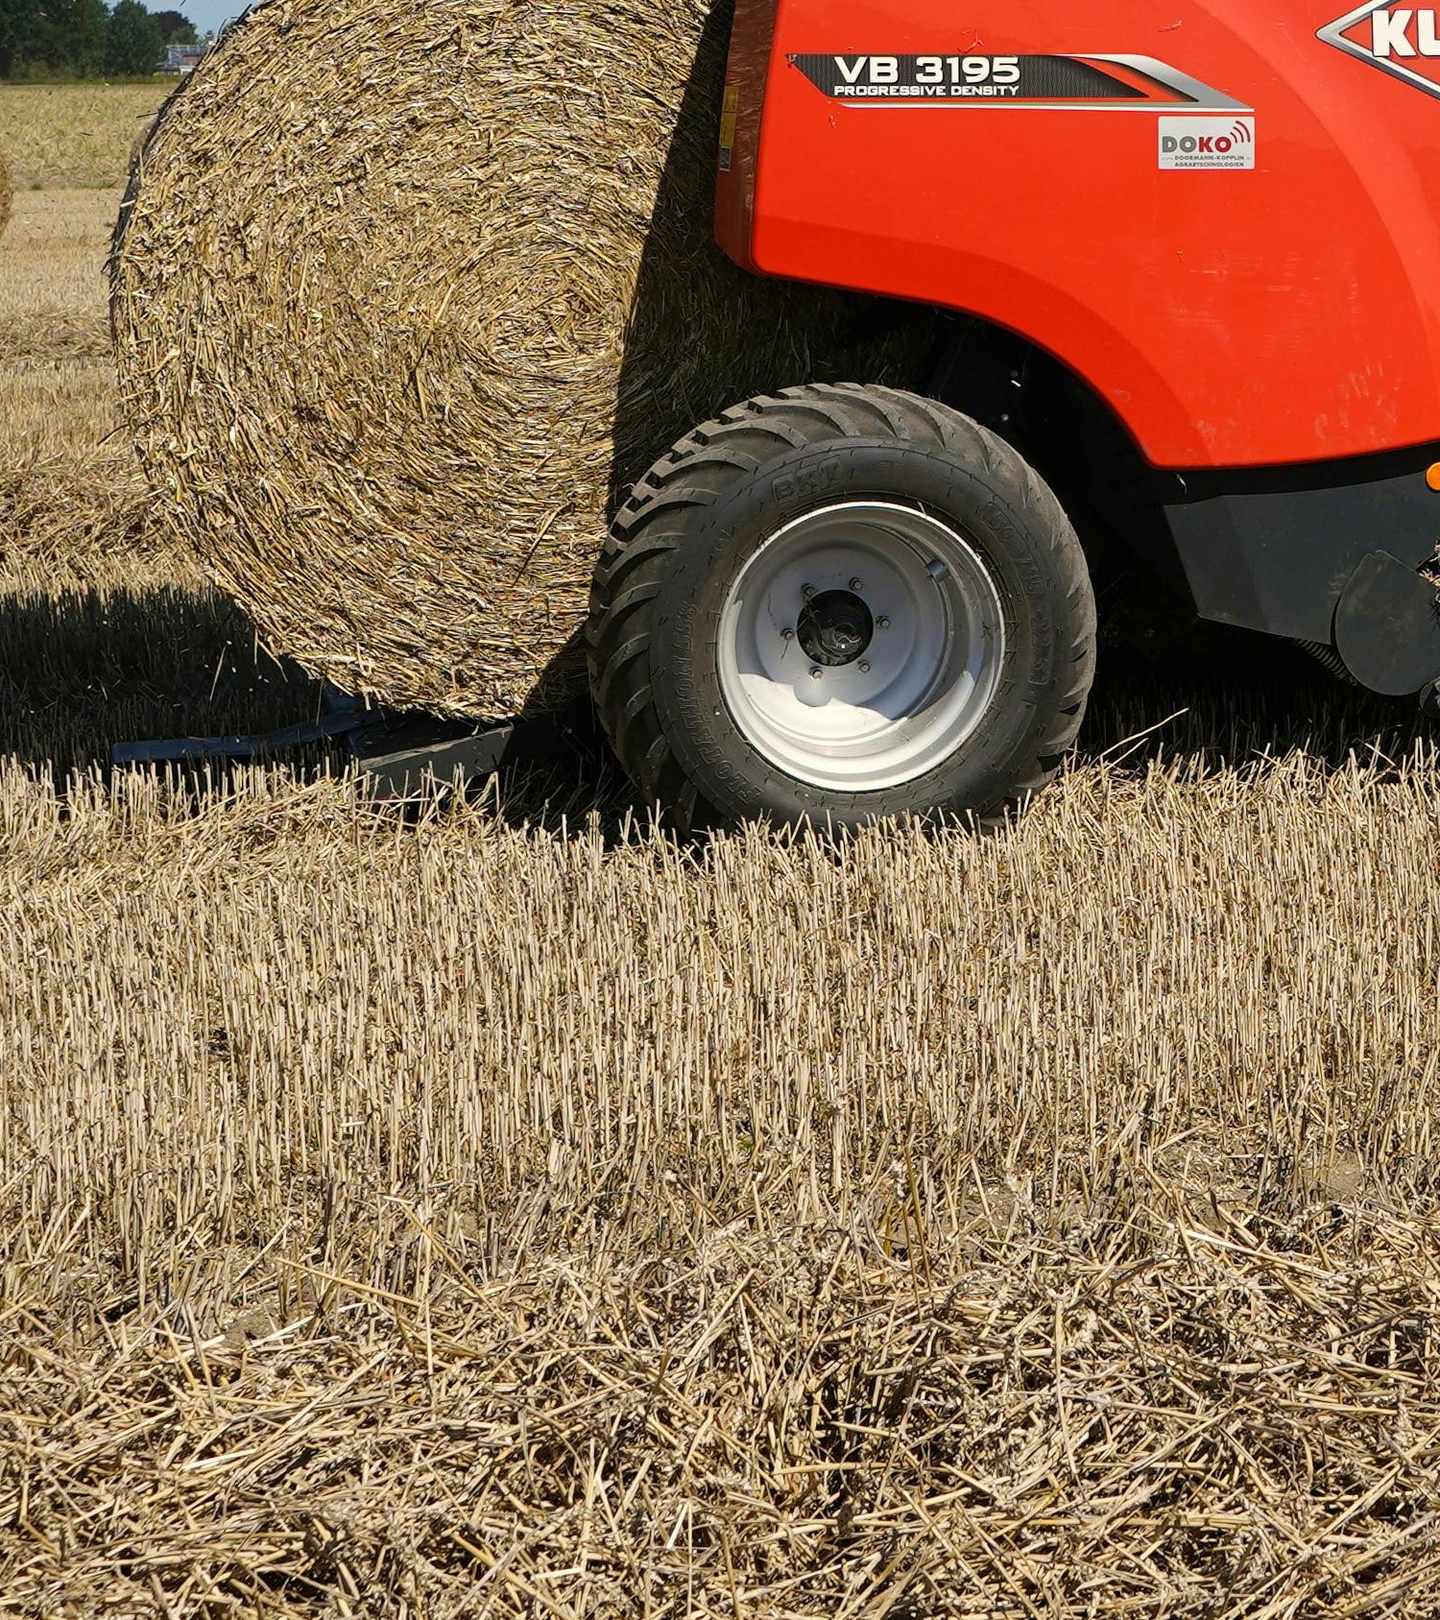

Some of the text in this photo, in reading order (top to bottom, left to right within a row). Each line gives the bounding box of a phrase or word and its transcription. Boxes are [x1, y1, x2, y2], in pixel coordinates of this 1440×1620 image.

[834, 56, 1021, 83] VB 3195
[834, 85, 1019, 96] PROGRESSIVE DENSITY
[1162, 136, 1232, 153] DOKO
